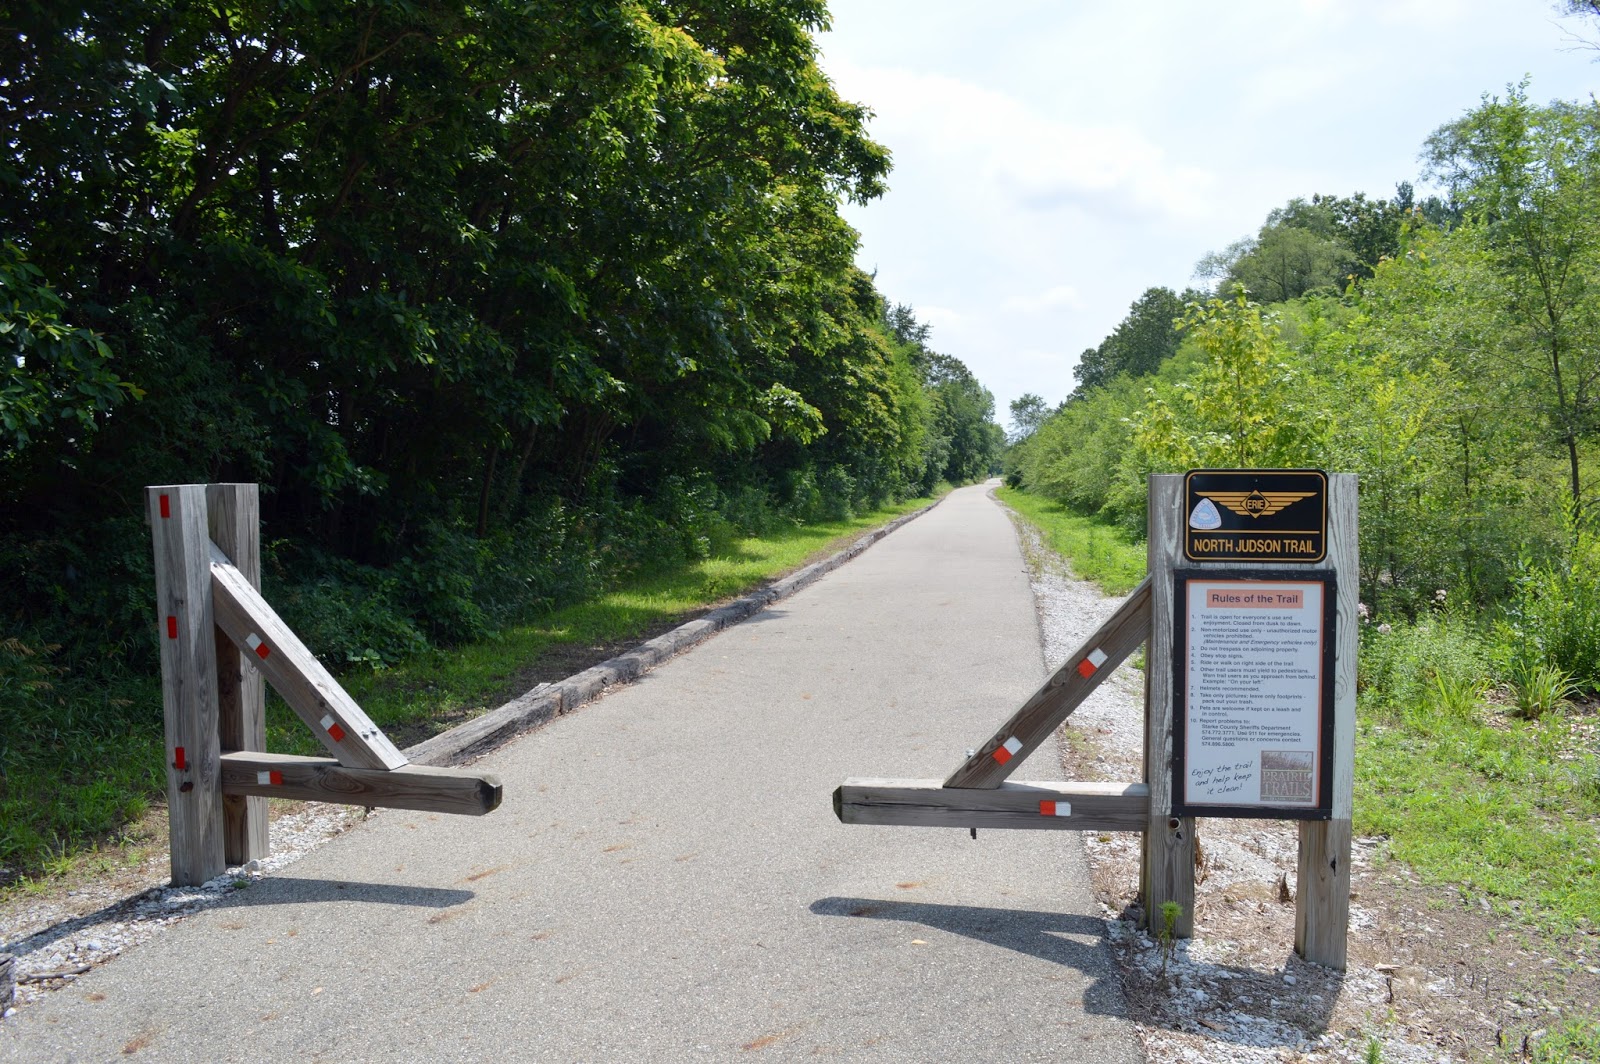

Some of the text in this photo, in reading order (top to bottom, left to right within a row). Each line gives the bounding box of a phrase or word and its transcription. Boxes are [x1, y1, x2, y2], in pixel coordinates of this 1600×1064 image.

[1248, 500, 1264, 510] ERIE
[1194, 539, 1316, 553] NORTH JUDSON TRAIL
[1212, 594, 1240, 603] Rules
[1258, 595, 1273, 603] the
[1276, 595, 1298, 603] Trail
[1192, 769, 1213, 778] Enjoy
[1235, 760, 1253, 770] trail
[1195, 773, 1252, 786] and help keep
[1217, 783, 1242, 793] clean!
[1263, 781, 1311, 795] TRAILS
